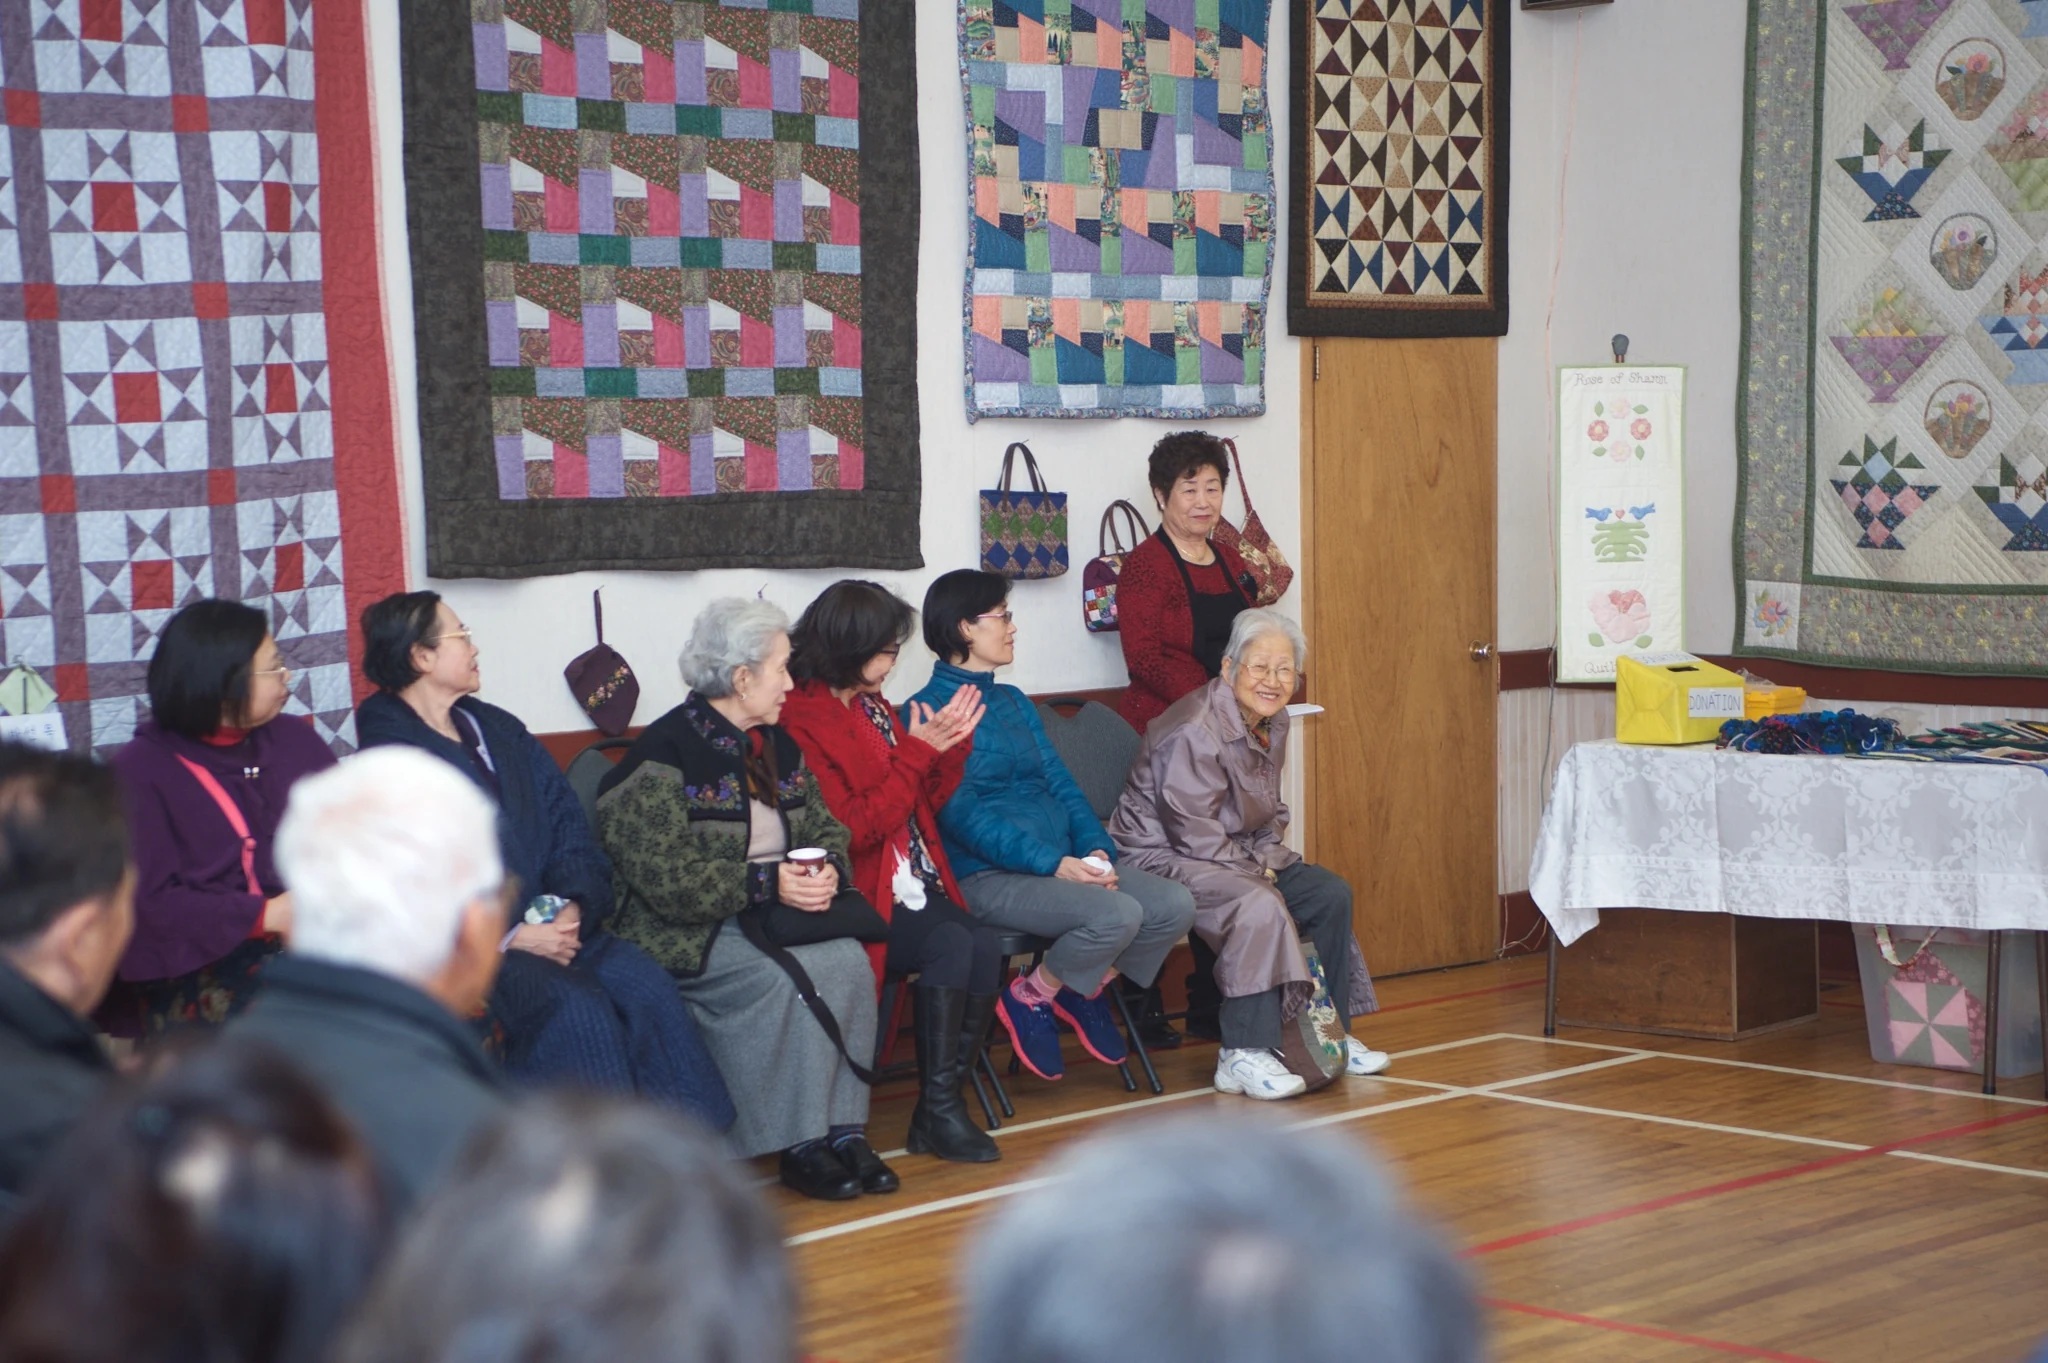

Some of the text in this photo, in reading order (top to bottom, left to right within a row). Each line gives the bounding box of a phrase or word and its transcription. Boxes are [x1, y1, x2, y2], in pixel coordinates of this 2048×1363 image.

[1573, 373, 1603, 386] Rose
[1610, 372, 1624, 385] of
[1689, 693, 1741, 712] DONATION
